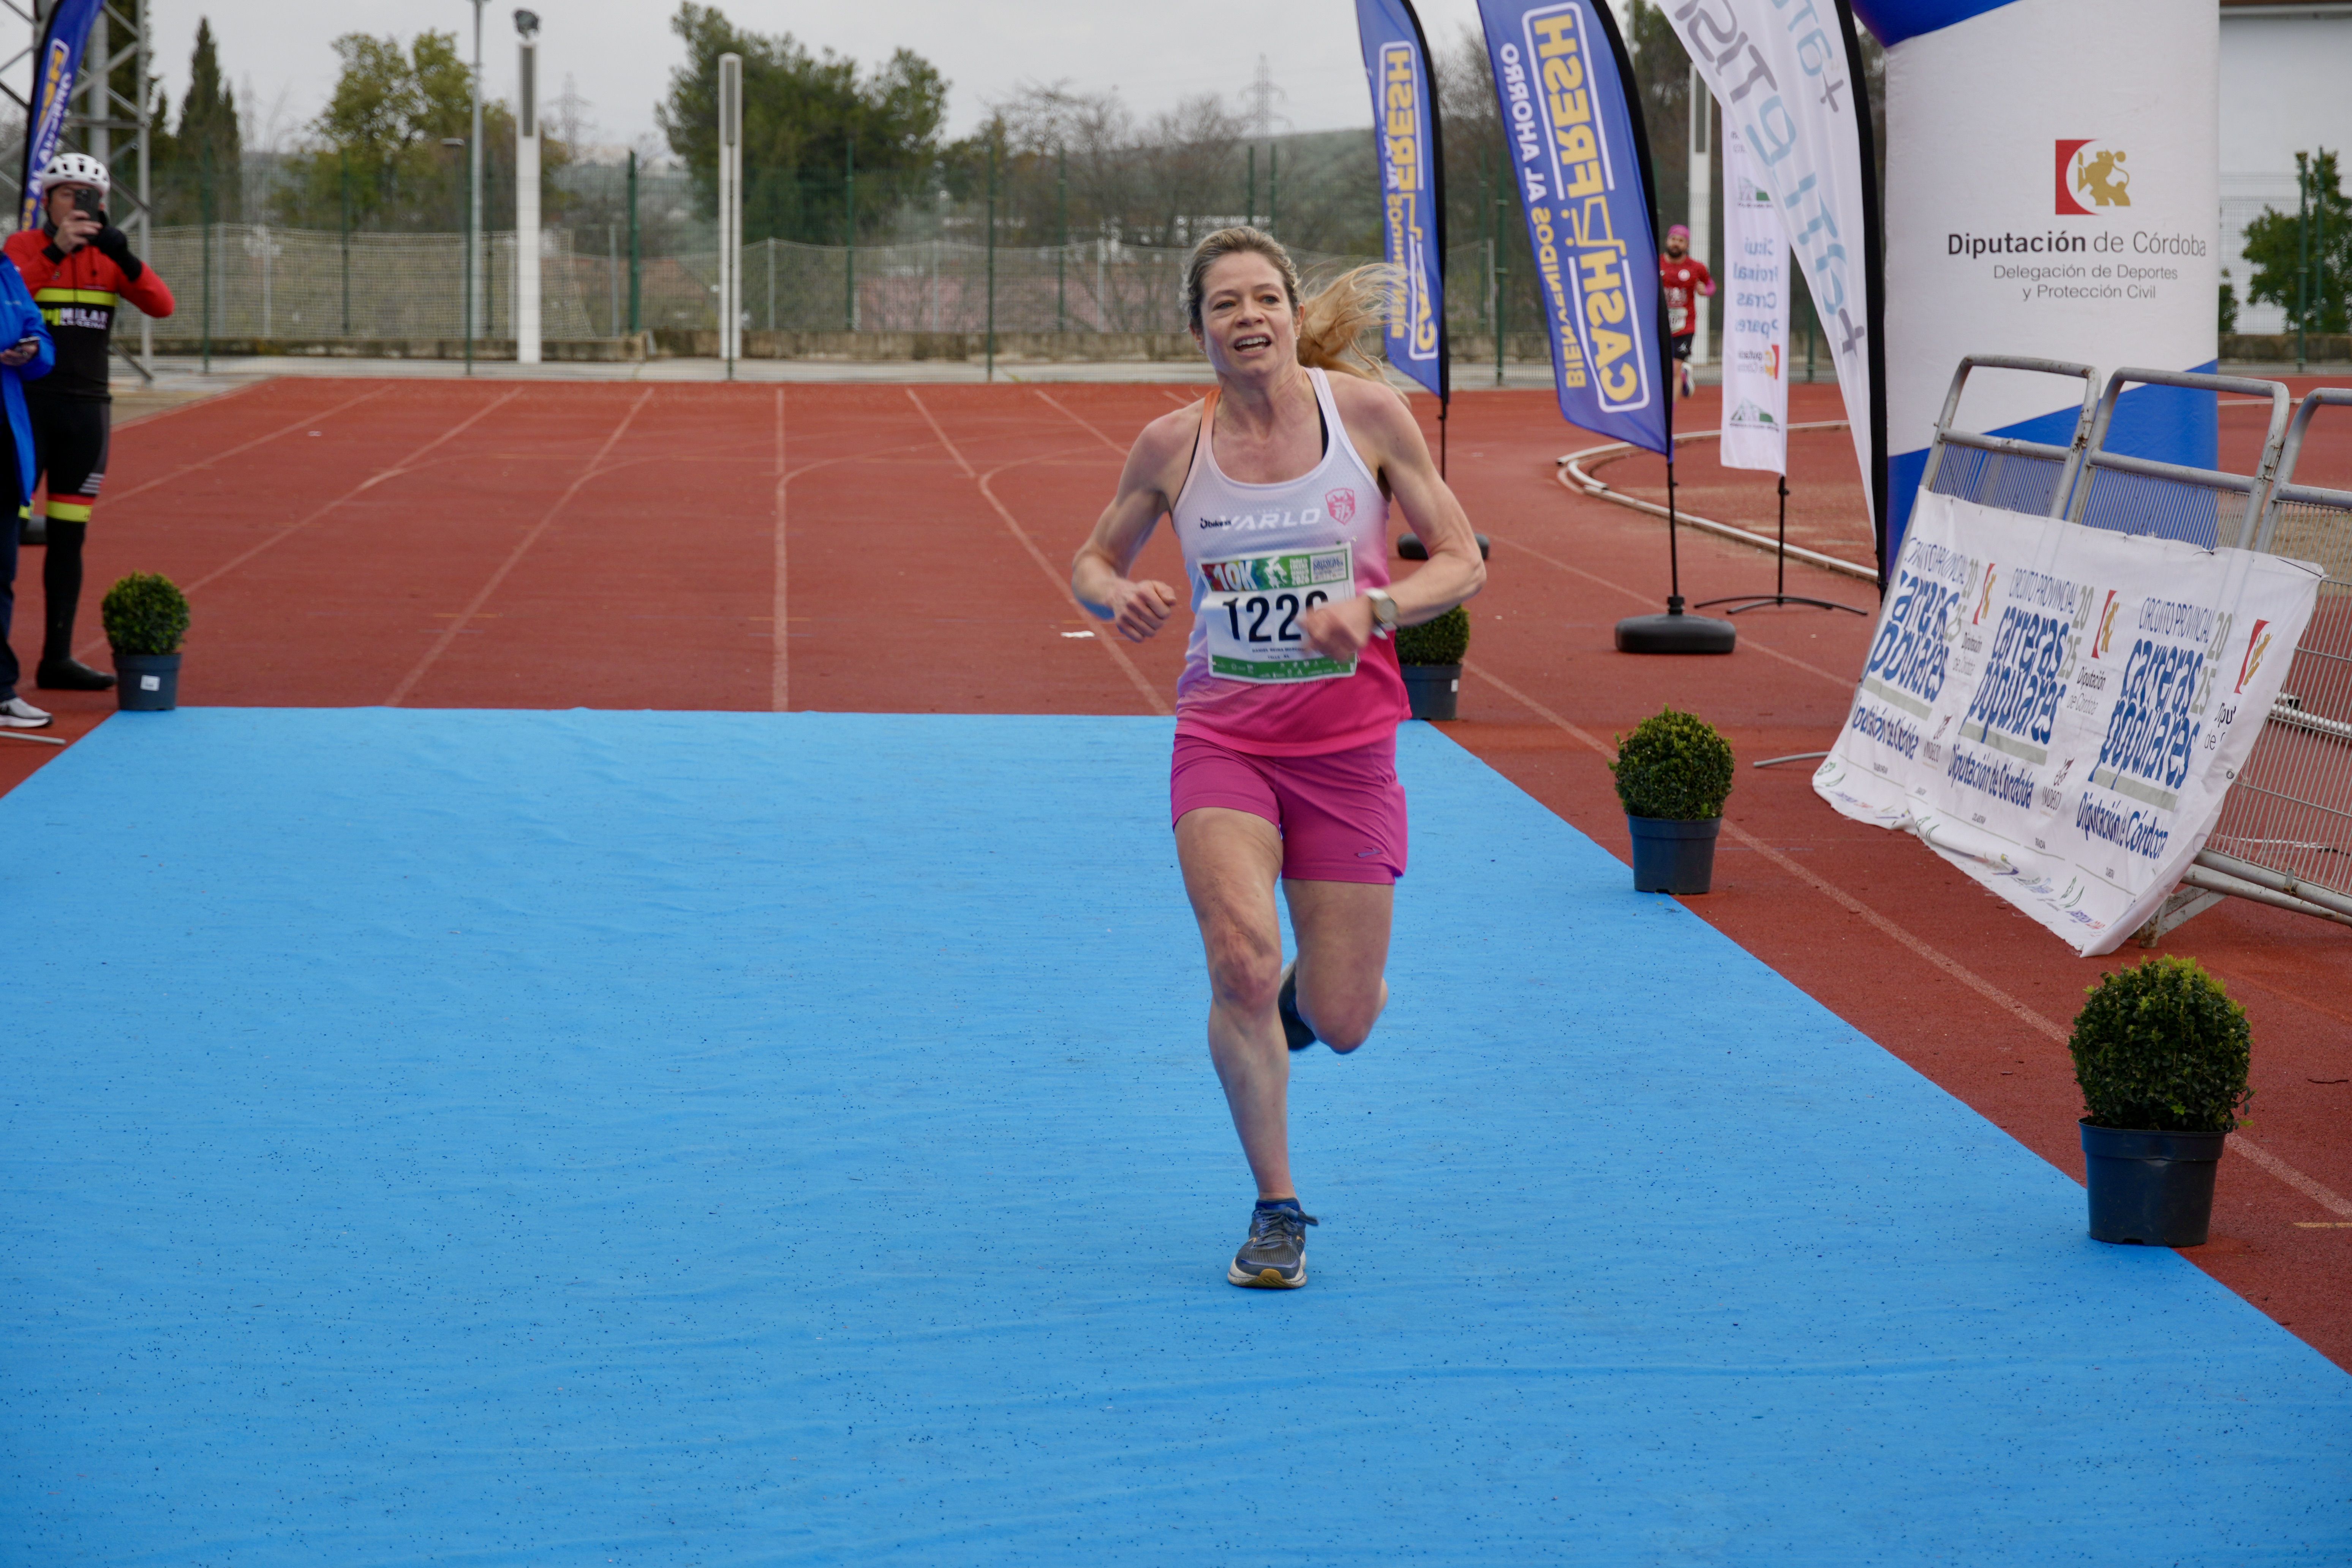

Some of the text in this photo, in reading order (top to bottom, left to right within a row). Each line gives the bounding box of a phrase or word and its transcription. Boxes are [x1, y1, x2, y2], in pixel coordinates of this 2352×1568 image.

[1948, 231, 2206, 259] Diputación de Córdoba
[1993, 264, 2178, 281] Delegación de Deportes
[2022, 284, 2156, 301] y Protección Civil
[1220, 508, 1321, 532] VARLO
[1213, 560, 1258, 591] 10K
[2072, 585, 2094, 631] 20
[2139, 597, 2175, 634] CIRCUITO
[1992, 605, 2069, 680] carreras
[2058, 634, 2082, 680] 25
[2207, 612, 2233, 661] 20
[2077, 666, 2106, 691] Diputación
[2121, 638, 2203, 718] carreras
[2189, 665, 2217, 716] 25
[1958, 661, 2066, 744] populares
[2088, 700, 2200, 790] populares
[1947, 743, 1990, 793] Diputación
[1999, 762, 2034, 809] Córdoba
[2076, 792, 2122, 842] Diputación
